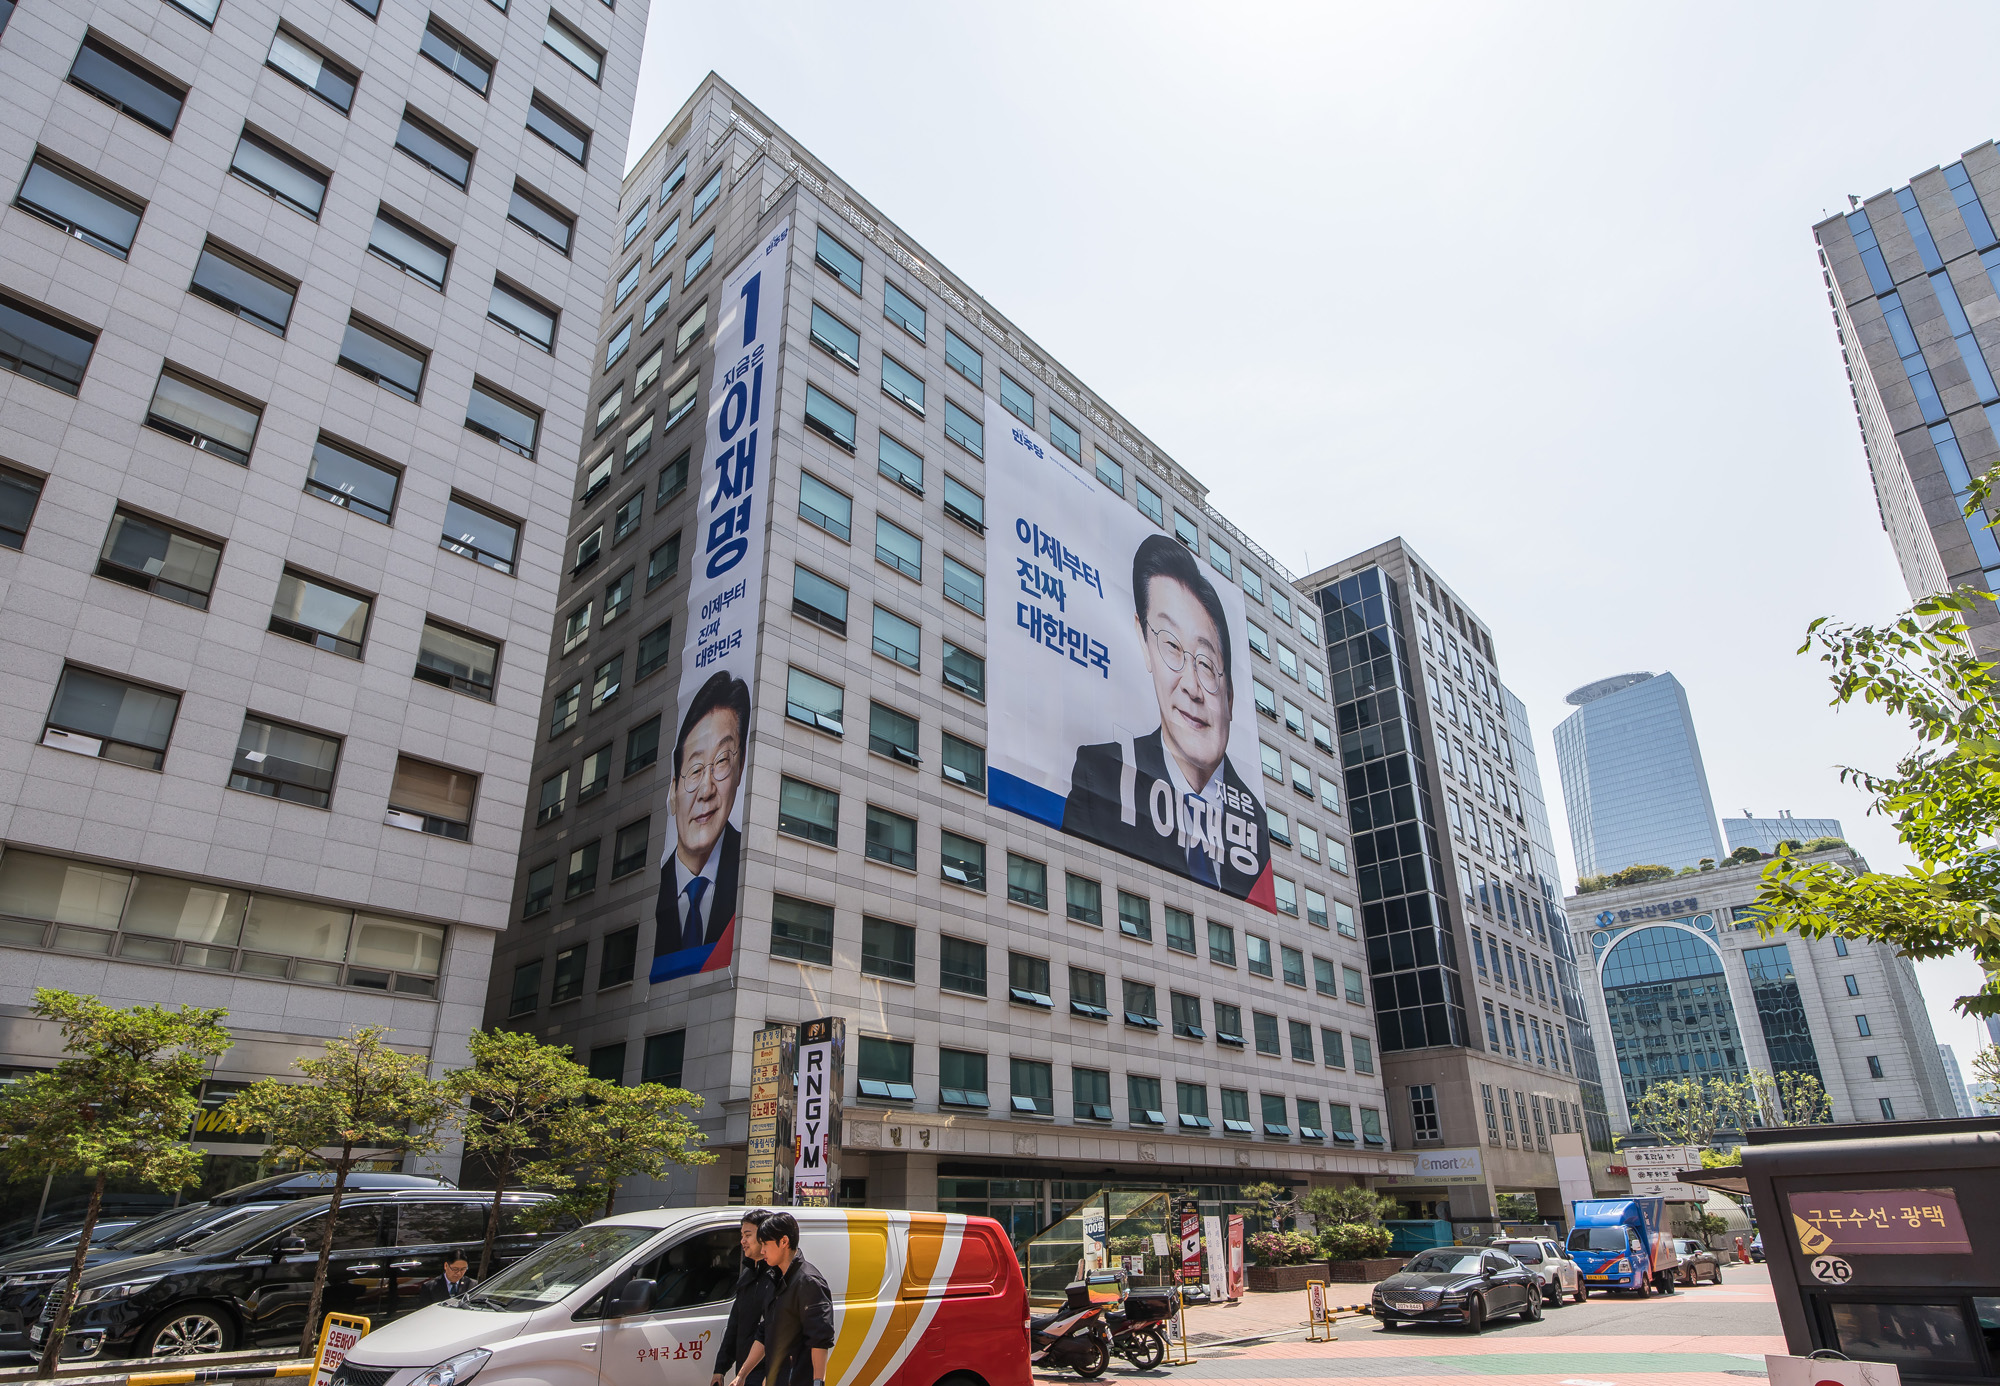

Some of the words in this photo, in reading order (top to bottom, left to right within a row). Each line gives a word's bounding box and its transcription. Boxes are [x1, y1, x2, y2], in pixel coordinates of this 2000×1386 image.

[765, 228, 788, 256] 민주당
[741, 270, 761, 348] 1
[722, 343, 765, 392] 지금은
[1012, 427, 1044, 459] 민주당
[705, 366, 761, 580] 이재명
[1014, 517, 1104, 599] 이제부터
[701, 578, 747, 621] 이제부터
[1016, 557, 1067, 613] 진짜
[695, 628, 743, 669] 대한민국
[697, 618, 721, 647] 진짜
[1016, 601, 1111, 679] 대한민국
[1214, 777, 1255, 817] 지금은
[1150, 776, 1260, 876] 이재명
[1617, 897, 1698, 923] 한국산업은행
[757, 1101, 777, 1117] 노래방
[803, 1049, 823, 1168] RNGYM
[351, 1161, 399, 1172] SUBWAY
[1815, 1260, 1850, 1280] 26
[636, 1346, 670, 1363] 우체국
[672, 1340, 703, 1360] 쇼핑
